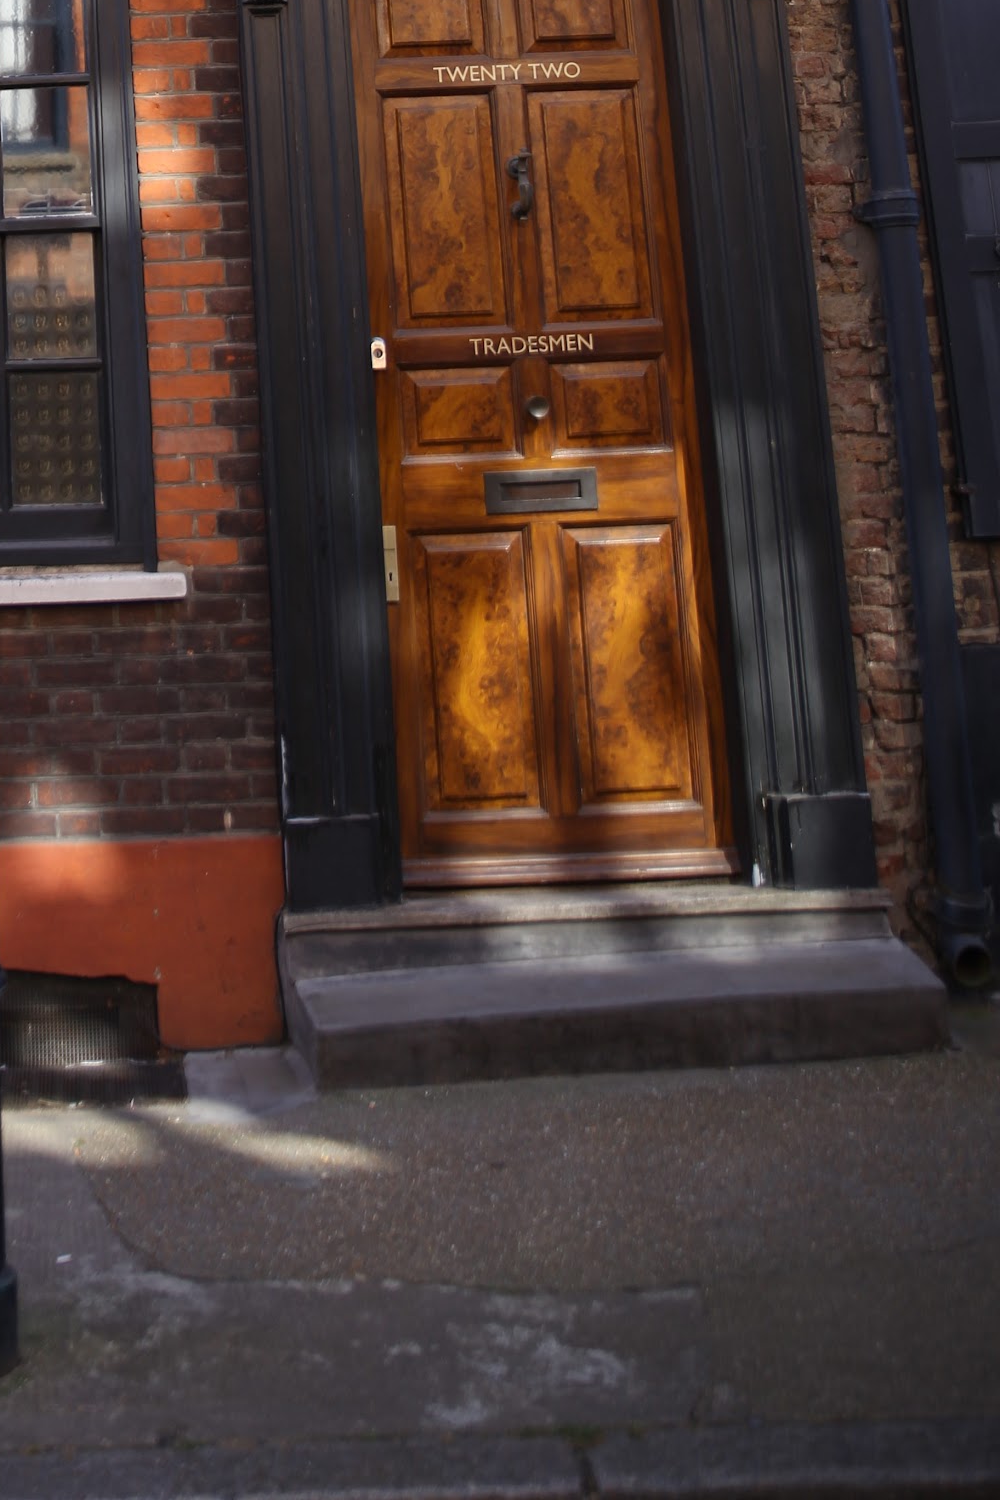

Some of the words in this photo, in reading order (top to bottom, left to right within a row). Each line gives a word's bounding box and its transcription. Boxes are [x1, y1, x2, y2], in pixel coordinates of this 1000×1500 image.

[433, 63, 522, 83] TWENTY
[528, 61, 581, 80] TWO
[469, 333, 594, 356] TRADESMEN
